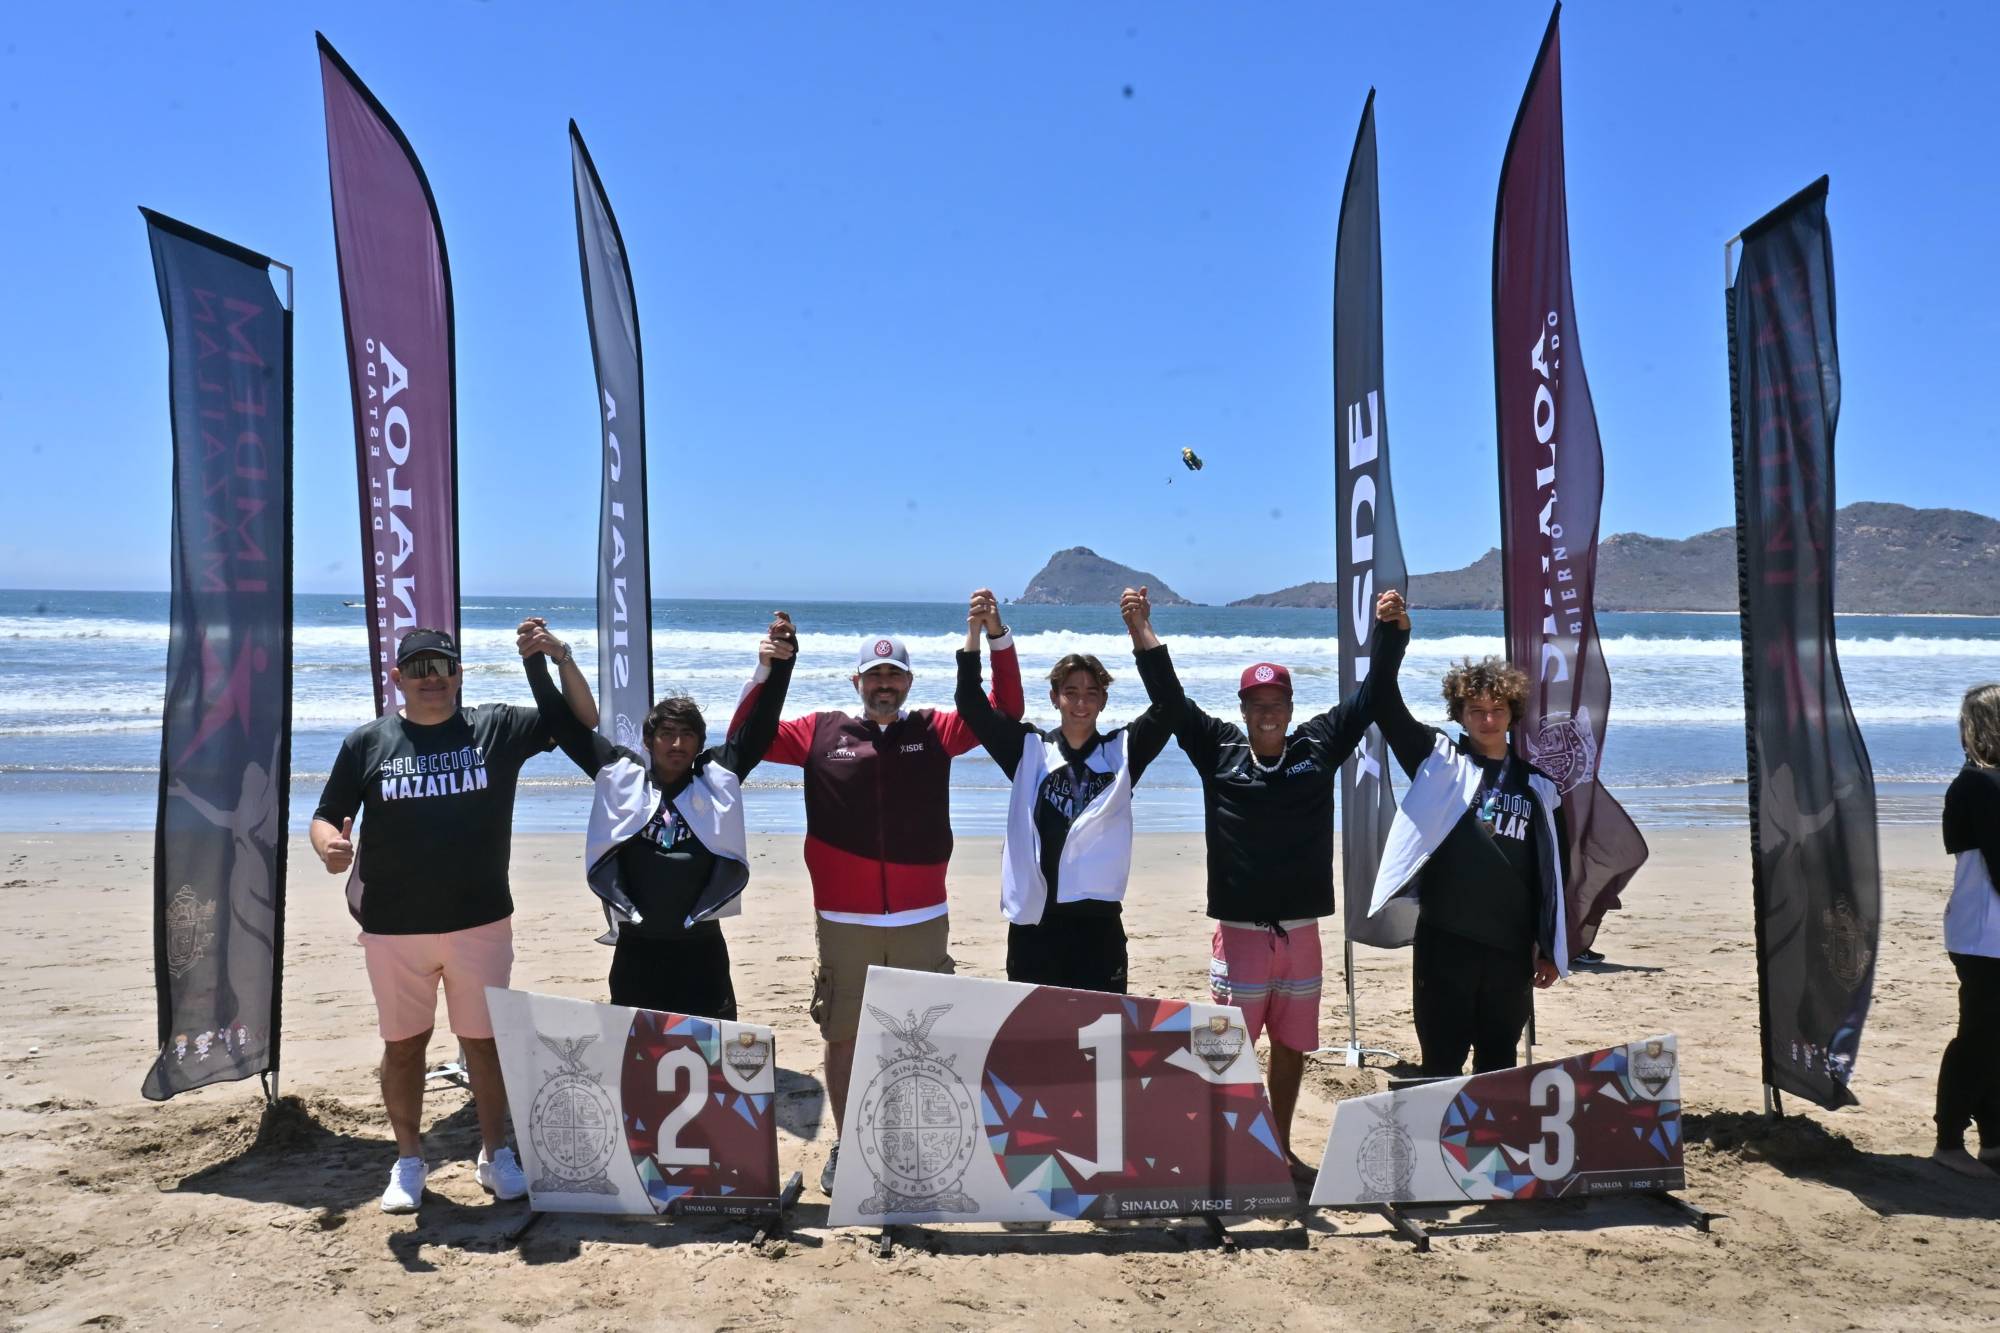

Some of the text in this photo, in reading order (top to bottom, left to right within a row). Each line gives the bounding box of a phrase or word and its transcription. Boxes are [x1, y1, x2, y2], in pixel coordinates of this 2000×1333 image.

[1531, 317, 1569, 683] SIALOA
[1550, 523, 1582, 654] BIERNO
[380, 745, 484, 778] SELECCIÓN
[381, 767, 488, 802] MAZATLÁN
[554, 1078, 593, 1088] SINALOA
[656, 1045, 710, 1166] 2
[891, 1063, 943, 1078] SINALOA
[1077, 1013, 1125, 1174] 1
[1529, 1068, 1576, 1182] 3
[1121, 1200, 1179, 1211] SINALOA
[1258, 1196, 1292, 1205] CONADE
